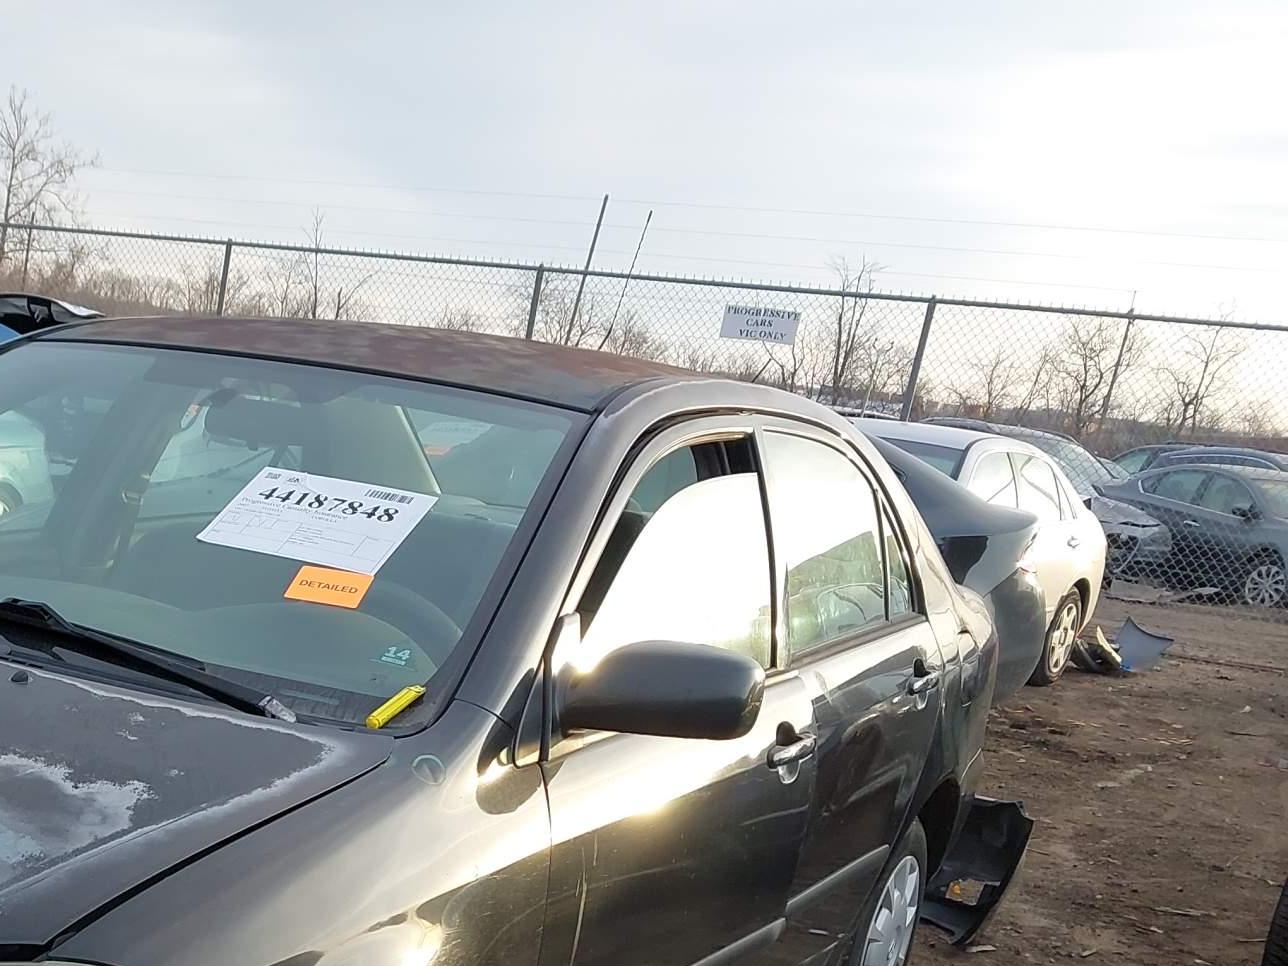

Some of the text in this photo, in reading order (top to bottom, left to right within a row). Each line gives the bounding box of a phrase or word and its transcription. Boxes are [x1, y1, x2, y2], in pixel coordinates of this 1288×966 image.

[726, 304, 802, 322] PROGRESSIVE
[745, 318, 774, 328] CARS
[739, 328, 787, 341] VIC ONLY
[258, 486, 400, 524] 44187848
[298, 578, 359, 596] DETAILED
[383, 646, 411, 661] 14
